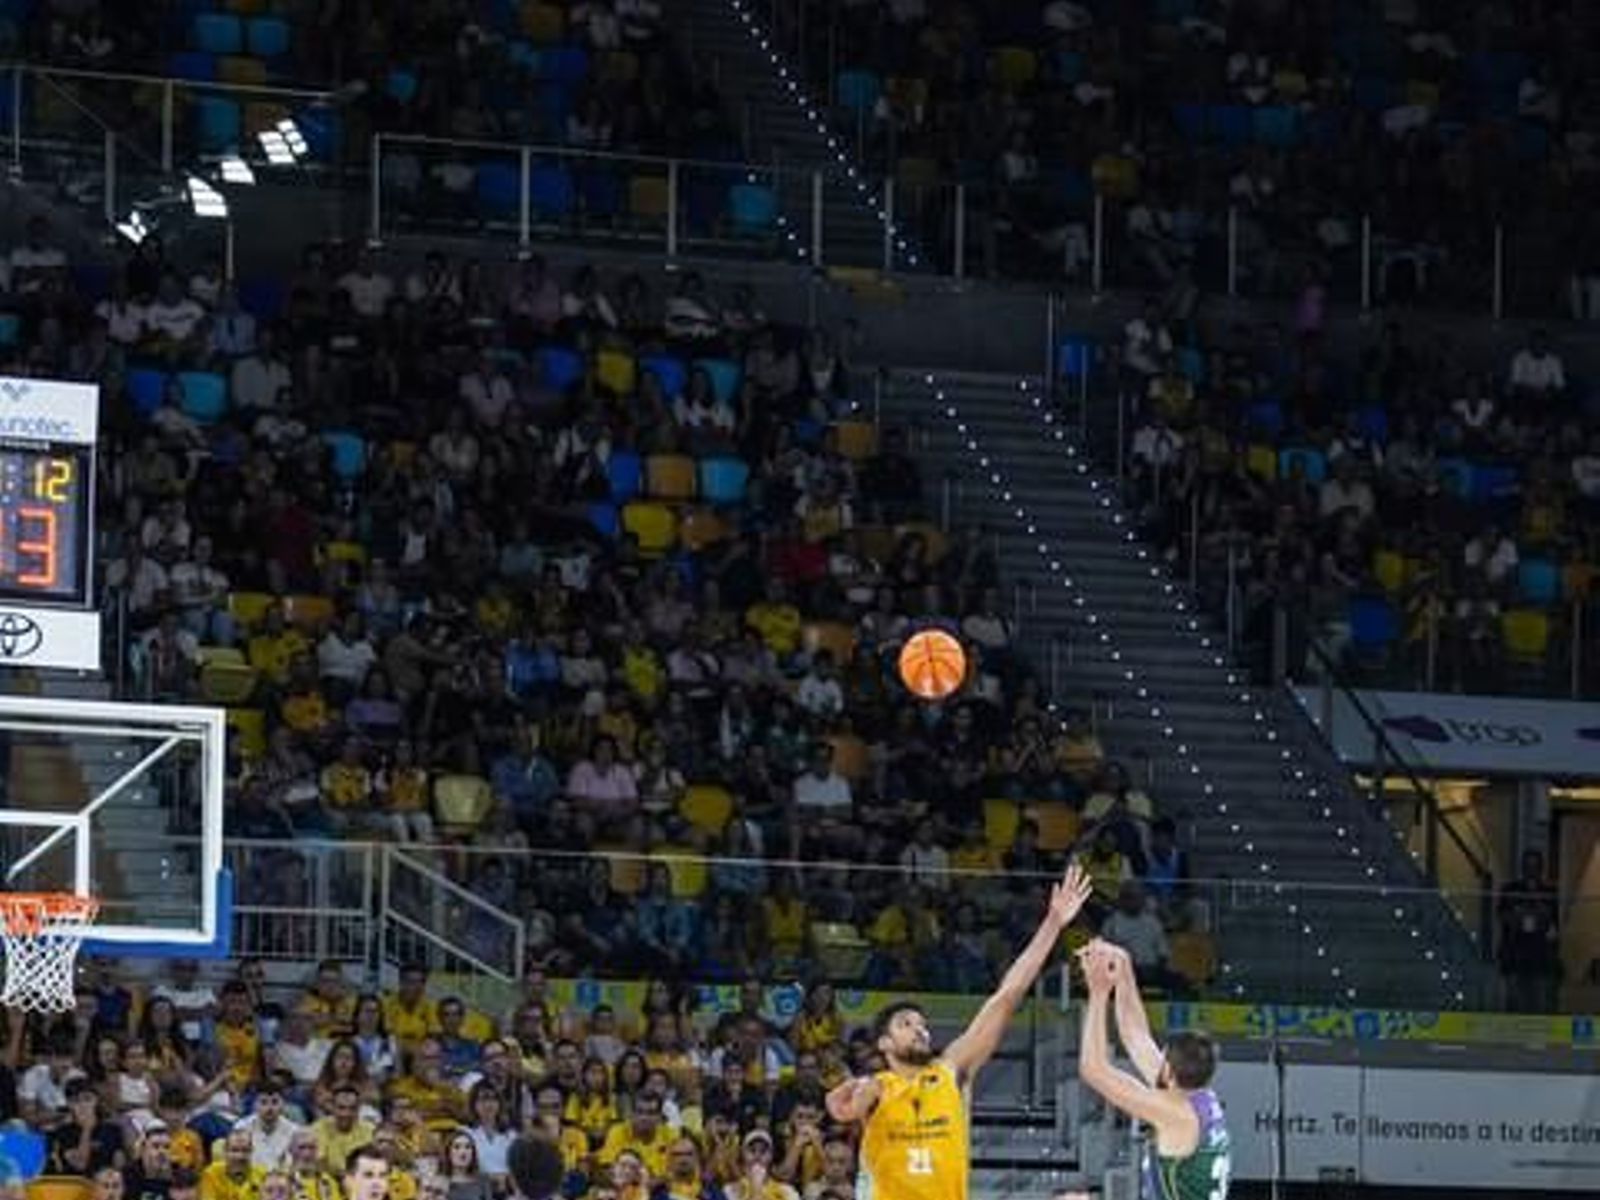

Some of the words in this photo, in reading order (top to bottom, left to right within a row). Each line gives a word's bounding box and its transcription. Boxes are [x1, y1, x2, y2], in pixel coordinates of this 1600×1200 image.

[1331, 1112, 1358, 1135] Te
[1365, 1115, 1470, 1140] llevamos
[1477, 1123, 1493, 1141] a
[1500, 1120, 1523, 1143] tu
